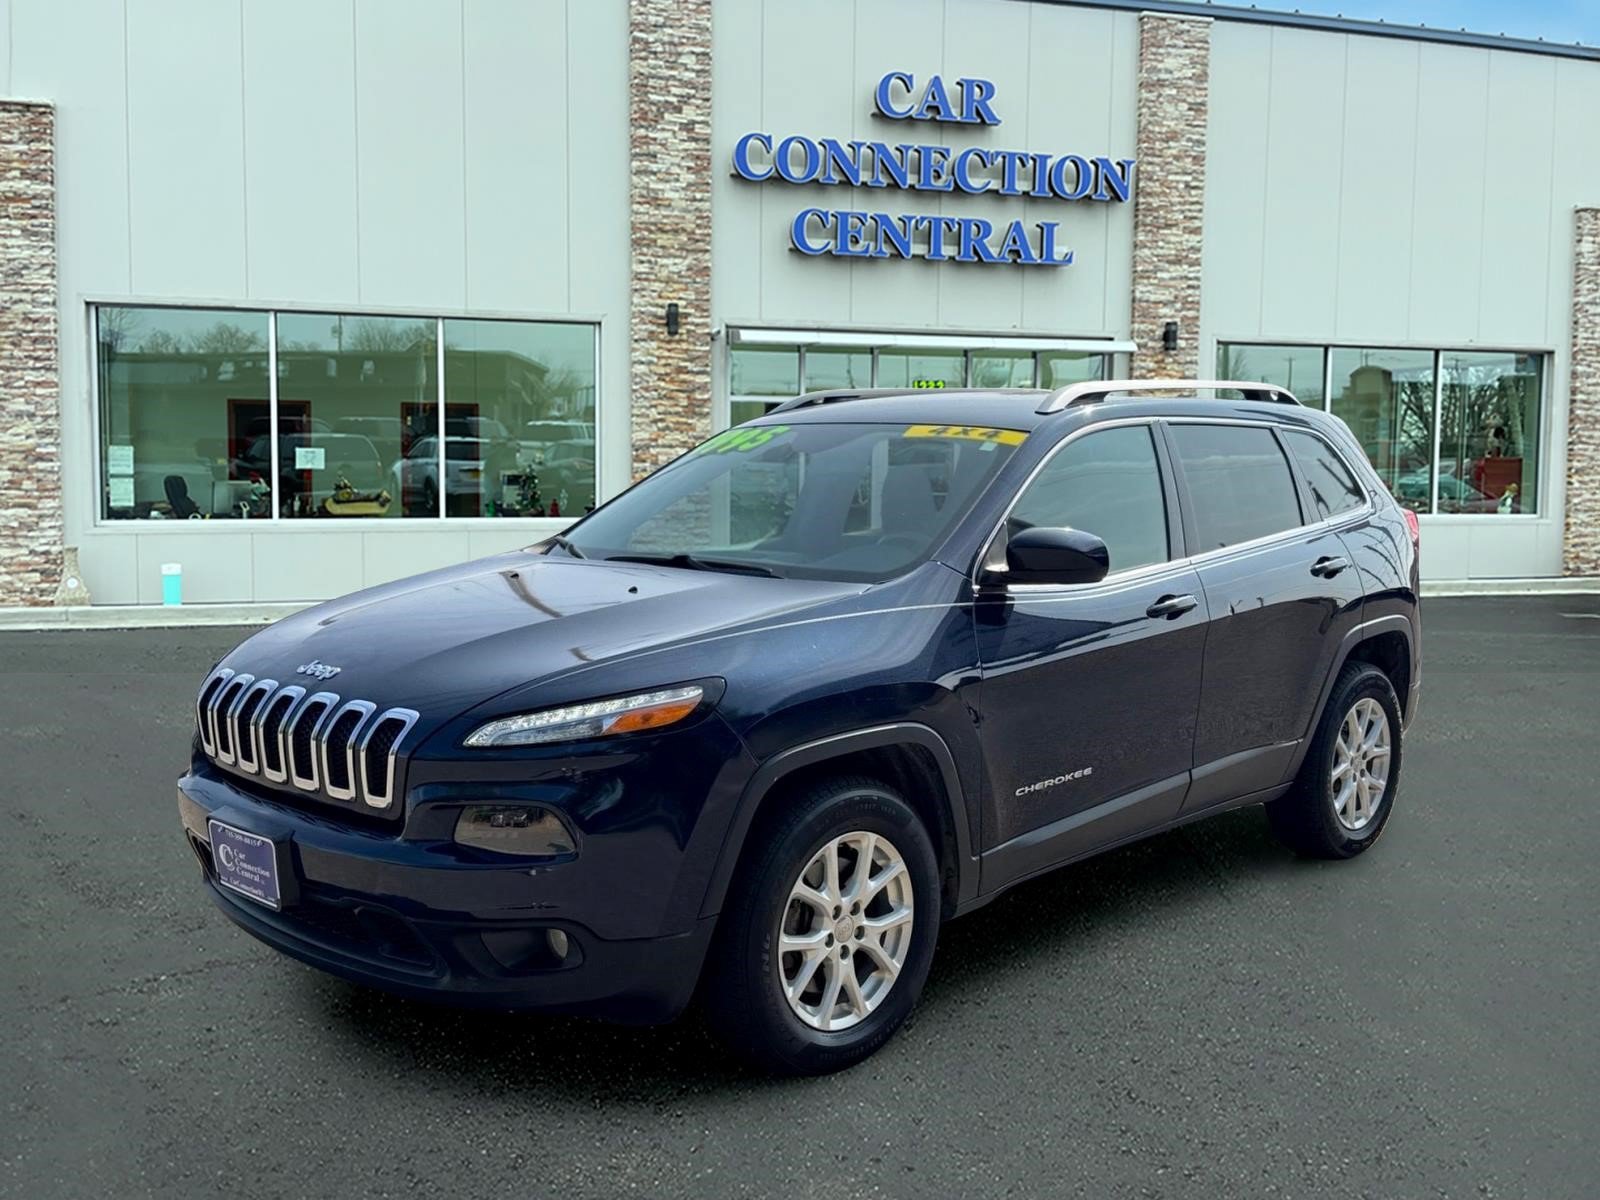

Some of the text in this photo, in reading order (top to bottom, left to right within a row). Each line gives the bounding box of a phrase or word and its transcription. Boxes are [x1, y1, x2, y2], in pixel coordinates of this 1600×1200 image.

[874, 70, 1001, 126] CAR
[731, 132, 1137, 203] CONNECTION
[790, 207, 1074, 267] CENTRAL
[296, 659, 342, 681] Jeep
[1015, 766, 1093, 797] CHEROKEE
[234, 857, 270, 878] Connection
[236, 866, 260, 883] Central
